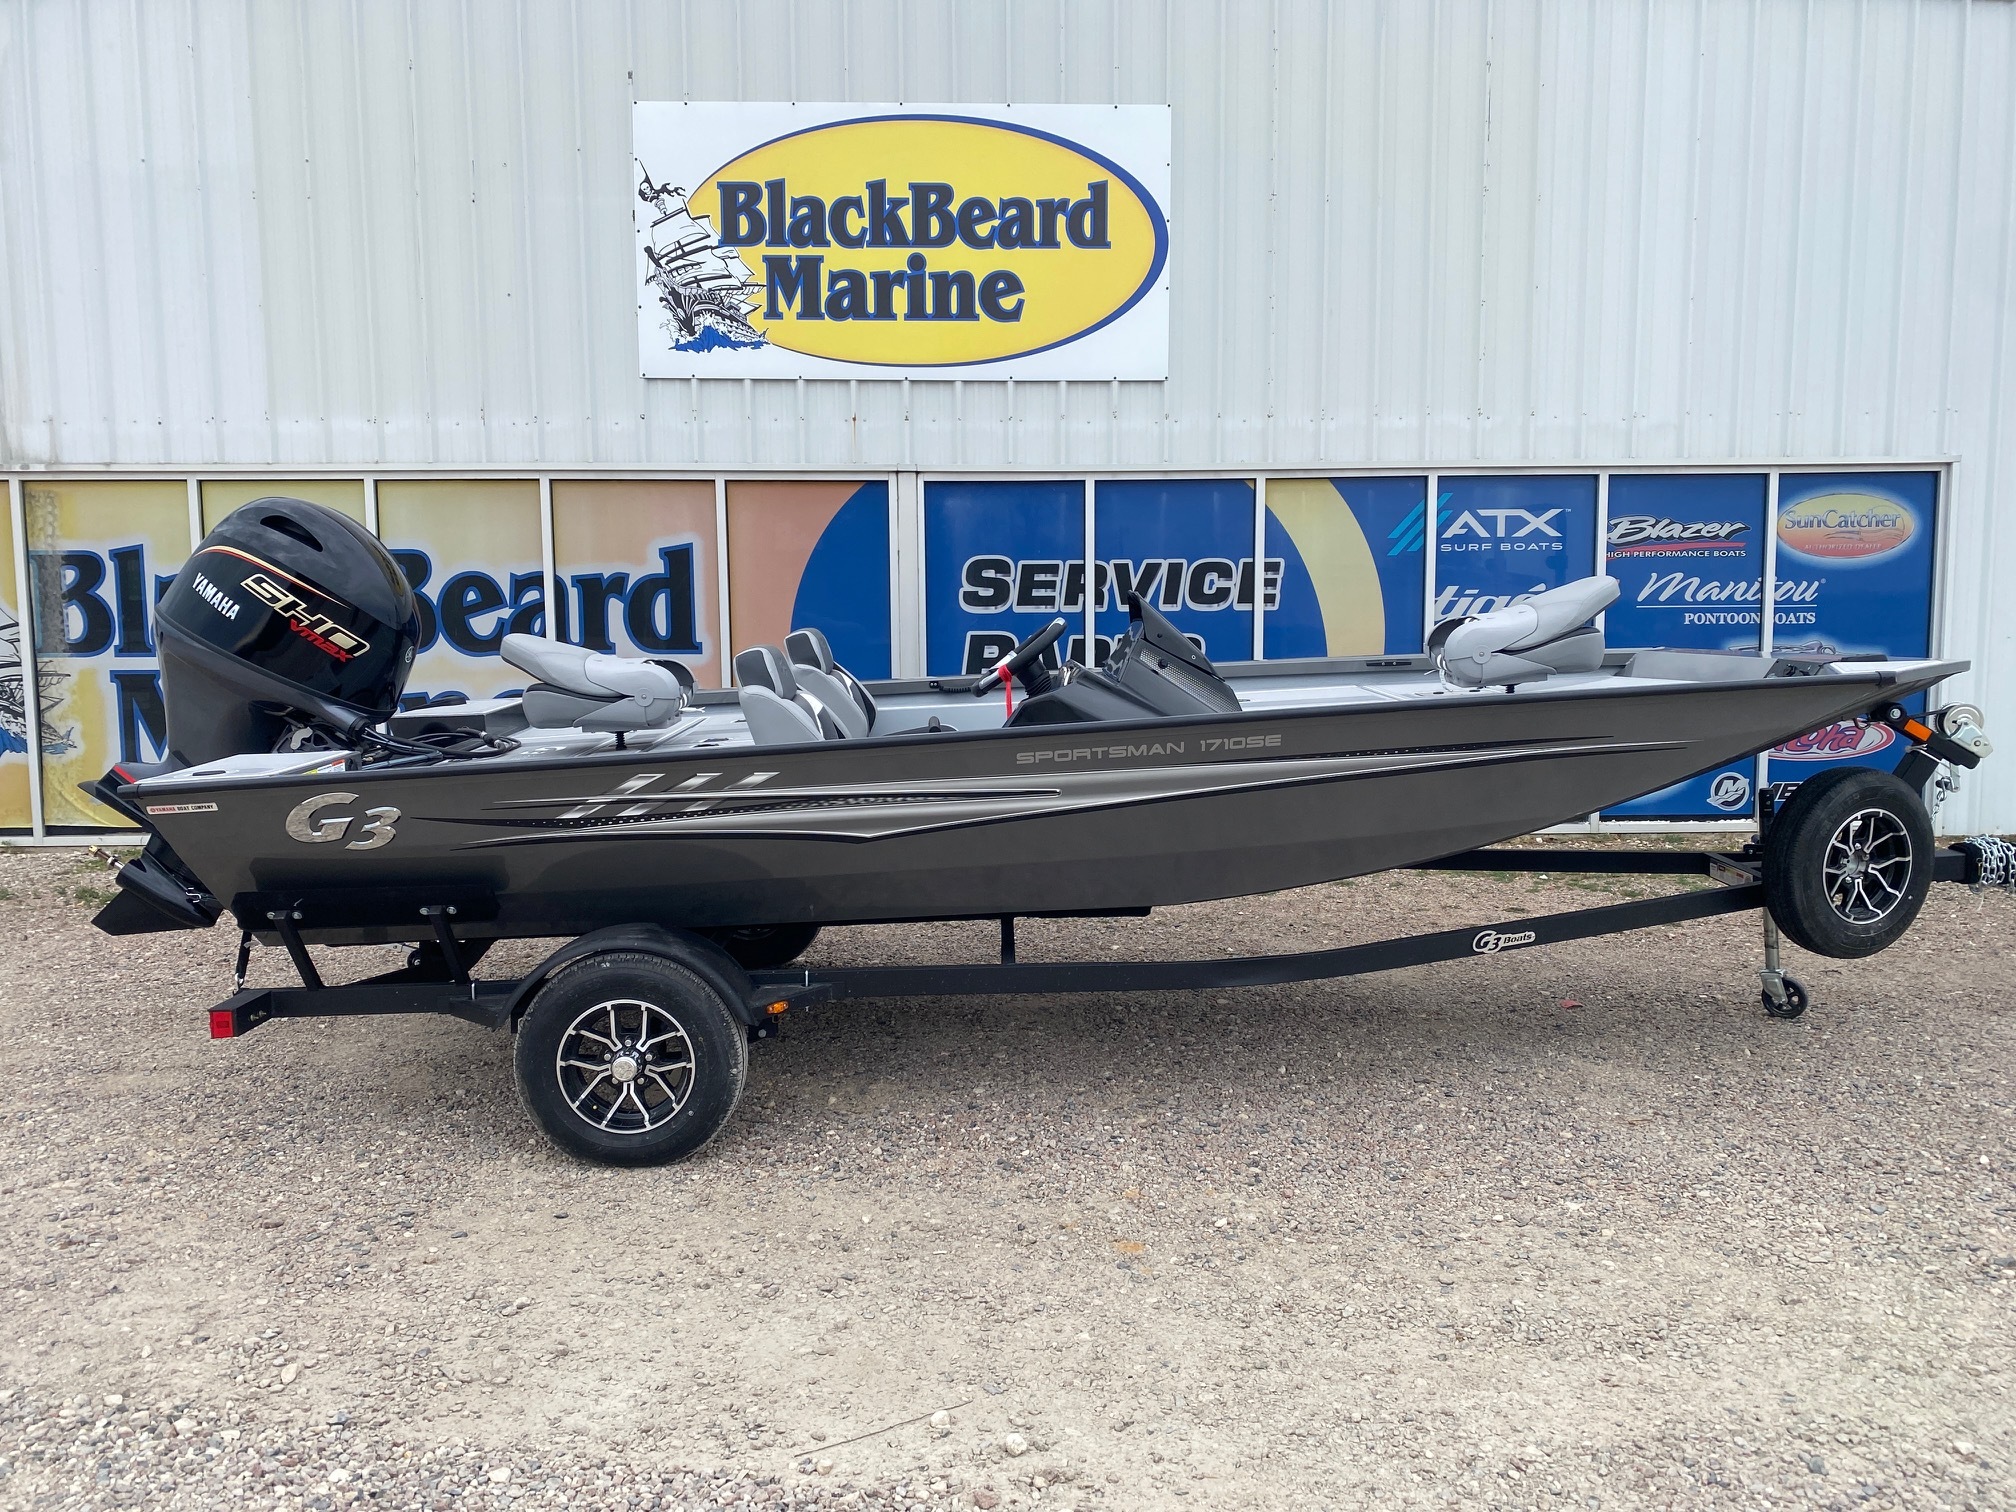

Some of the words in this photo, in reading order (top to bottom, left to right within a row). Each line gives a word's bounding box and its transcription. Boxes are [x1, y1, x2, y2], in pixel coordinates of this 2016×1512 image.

[716, 178, 1111, 250] BlackBeard
[762, 252, 1026, 323] Marine
[1441, 508, 1564, 538] ATX
[1607, 514, 1752, 547] Blazer
[1784, 509, 1901, 529] SunCatcher
[1440, 543, 1493, 552] SURF
[1500, 542, 1563, 551] BOATS
[1633, 550, 1710, 558] PERFORMANCE
[192, 572, 241, 621] YAMAHA
[959, 555, 1285, 613] SERVICE
[1637, 572, 1820, 602] Maniou
[240, 573, 371, 657] SHO
[1684, 612, 1762, 625] PONTOON
[1772, 612, 1816, 624] OATS
[1016, 741, 1185, 765] SPORTSMAN
[1200, 734, 1282, 752] 1710SE
[285, 791, 402, 852] G3
[1474, 931, 1502, 952] G3
[1503, 933, 1533, 944] Boats
